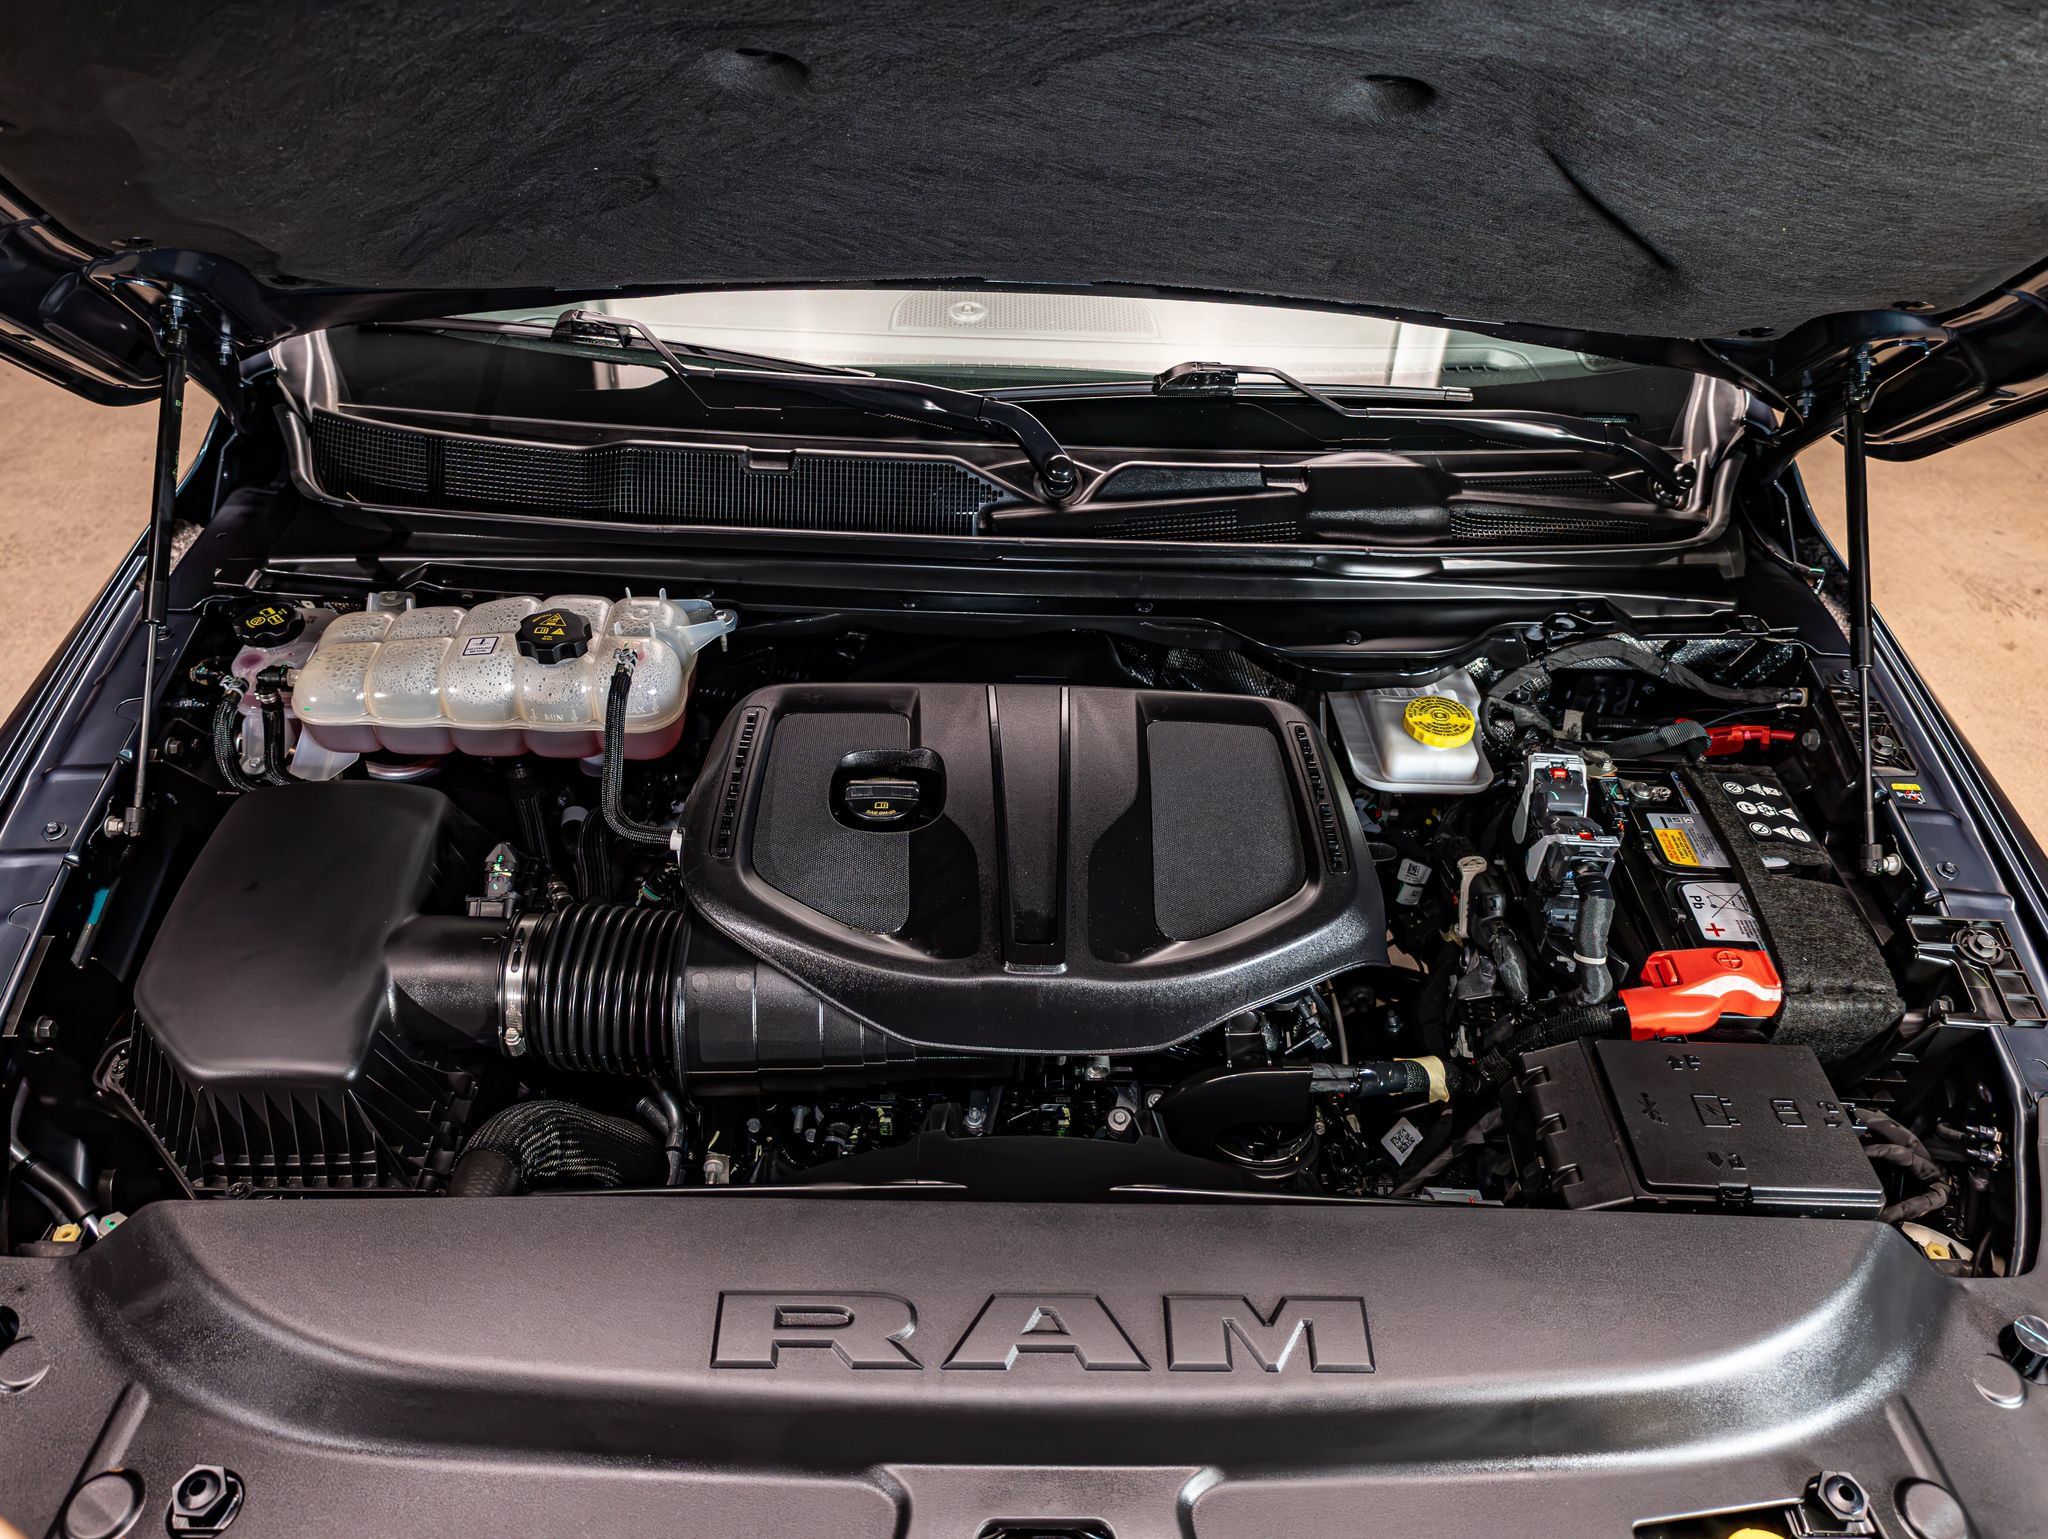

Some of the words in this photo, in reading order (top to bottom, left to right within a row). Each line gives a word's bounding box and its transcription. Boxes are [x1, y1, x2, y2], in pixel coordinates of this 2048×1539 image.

[544, 713, 564, 721] MIN
[1689, 895, 1705, 910] Pb
[709, 1290, 1377, 1374] RAM
